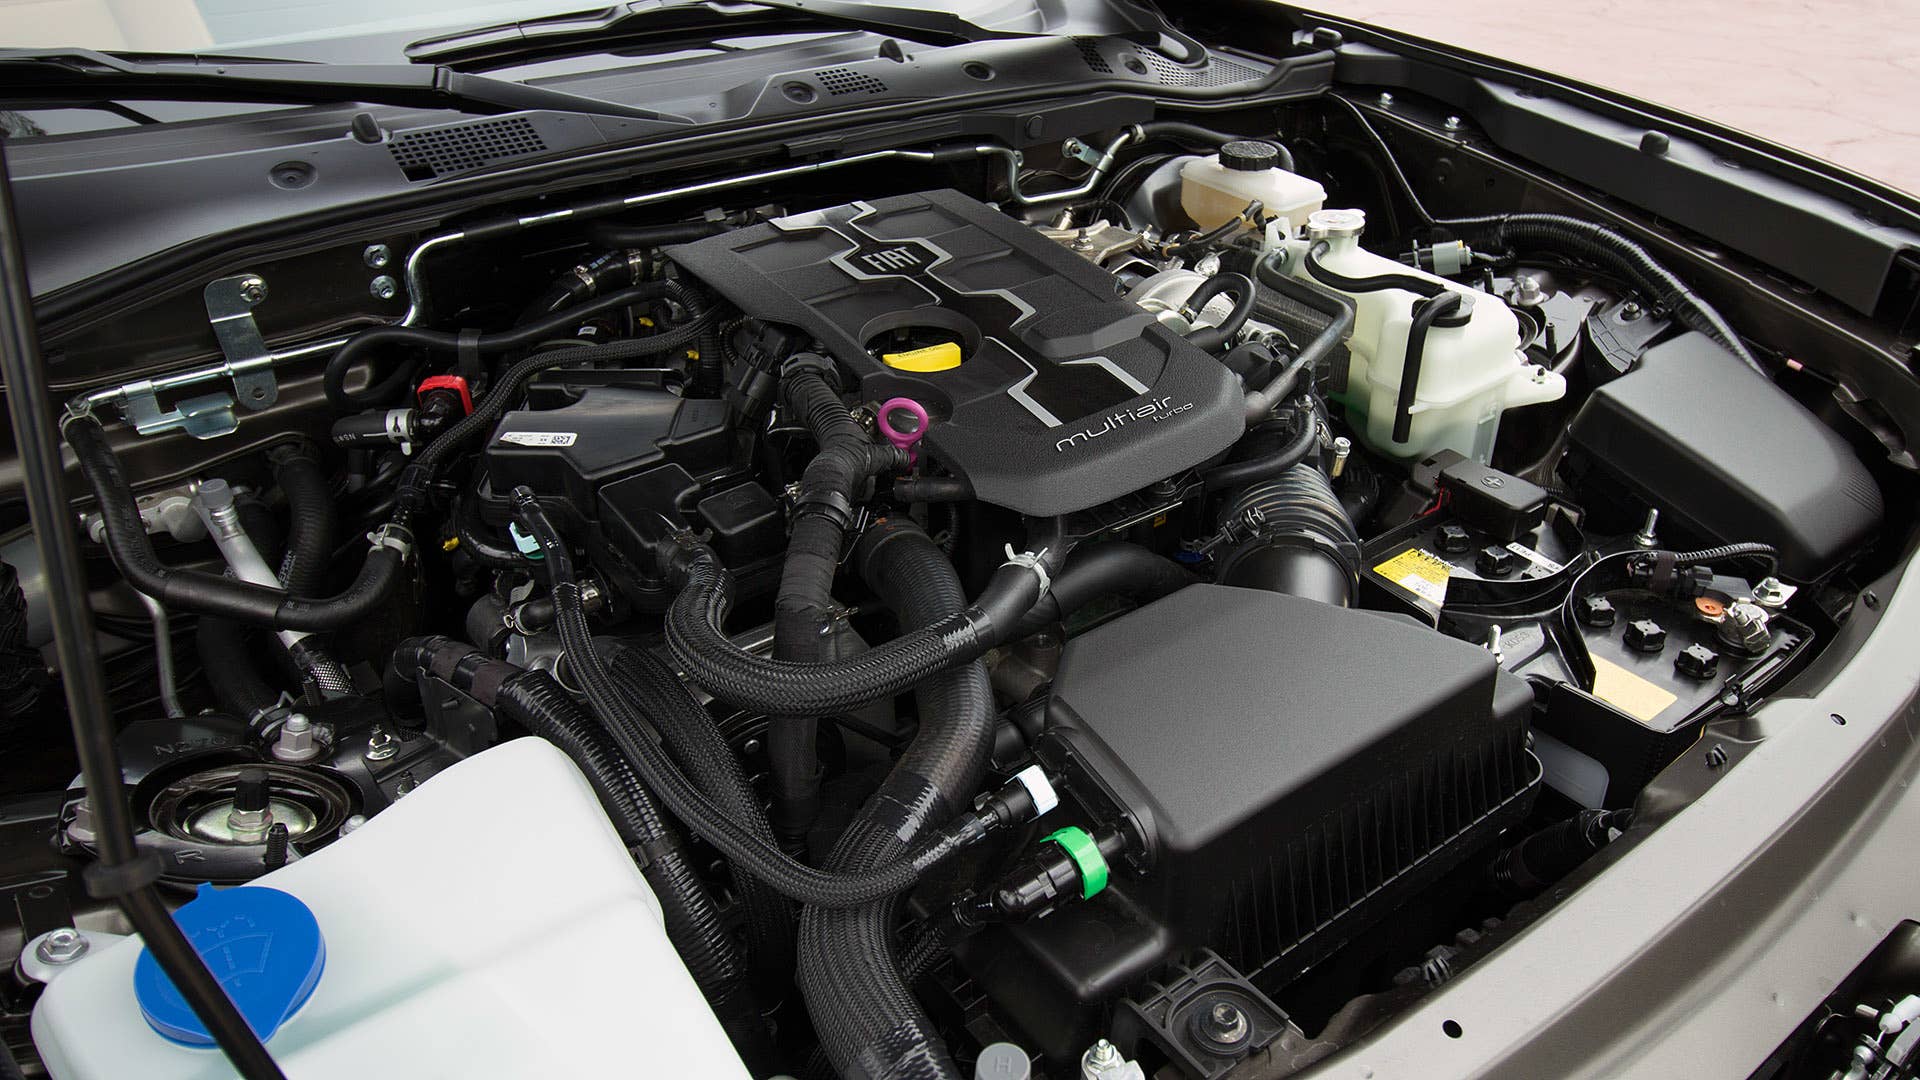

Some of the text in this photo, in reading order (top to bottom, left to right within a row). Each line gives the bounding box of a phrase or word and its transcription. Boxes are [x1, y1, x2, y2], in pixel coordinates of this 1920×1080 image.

[861, 246, 922, 272] FIAT
[1056, 396, 1171, 452] multiair
[1152, 402, 1194, 422] turbo
